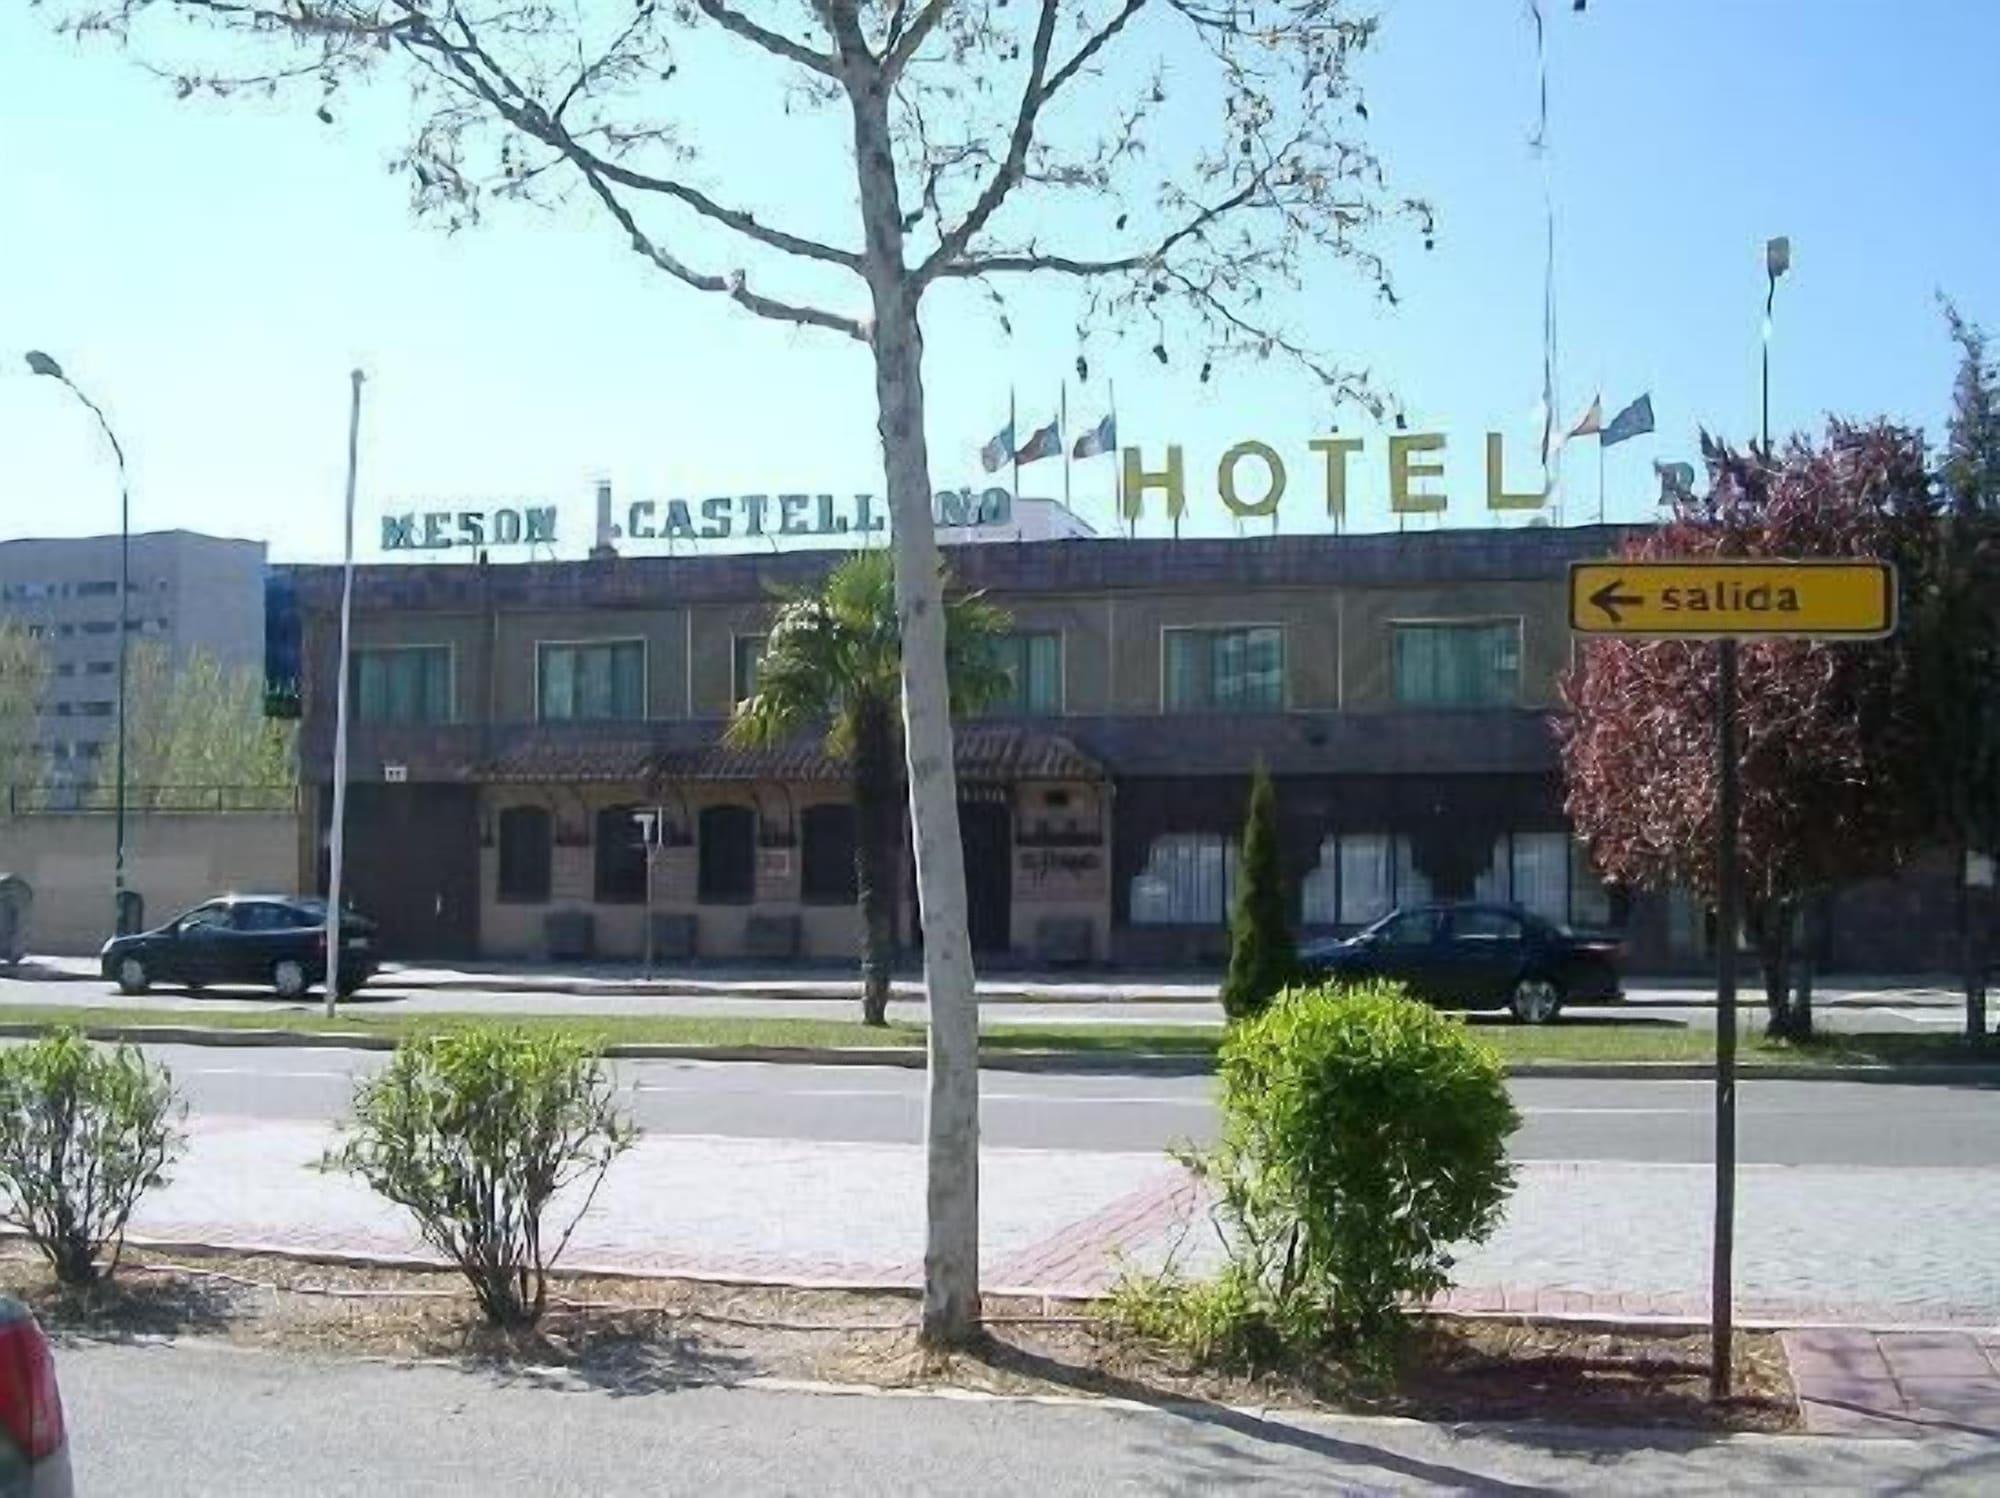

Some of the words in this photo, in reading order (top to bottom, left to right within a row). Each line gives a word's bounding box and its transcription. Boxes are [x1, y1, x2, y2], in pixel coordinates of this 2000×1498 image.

[1122, 432, 1549, 518] HOTEL
[381, 505, 557, 550] MESON
[629, 487, 1011, 539] CASTELLNO
[1661, 581, 1800, 611] salida
